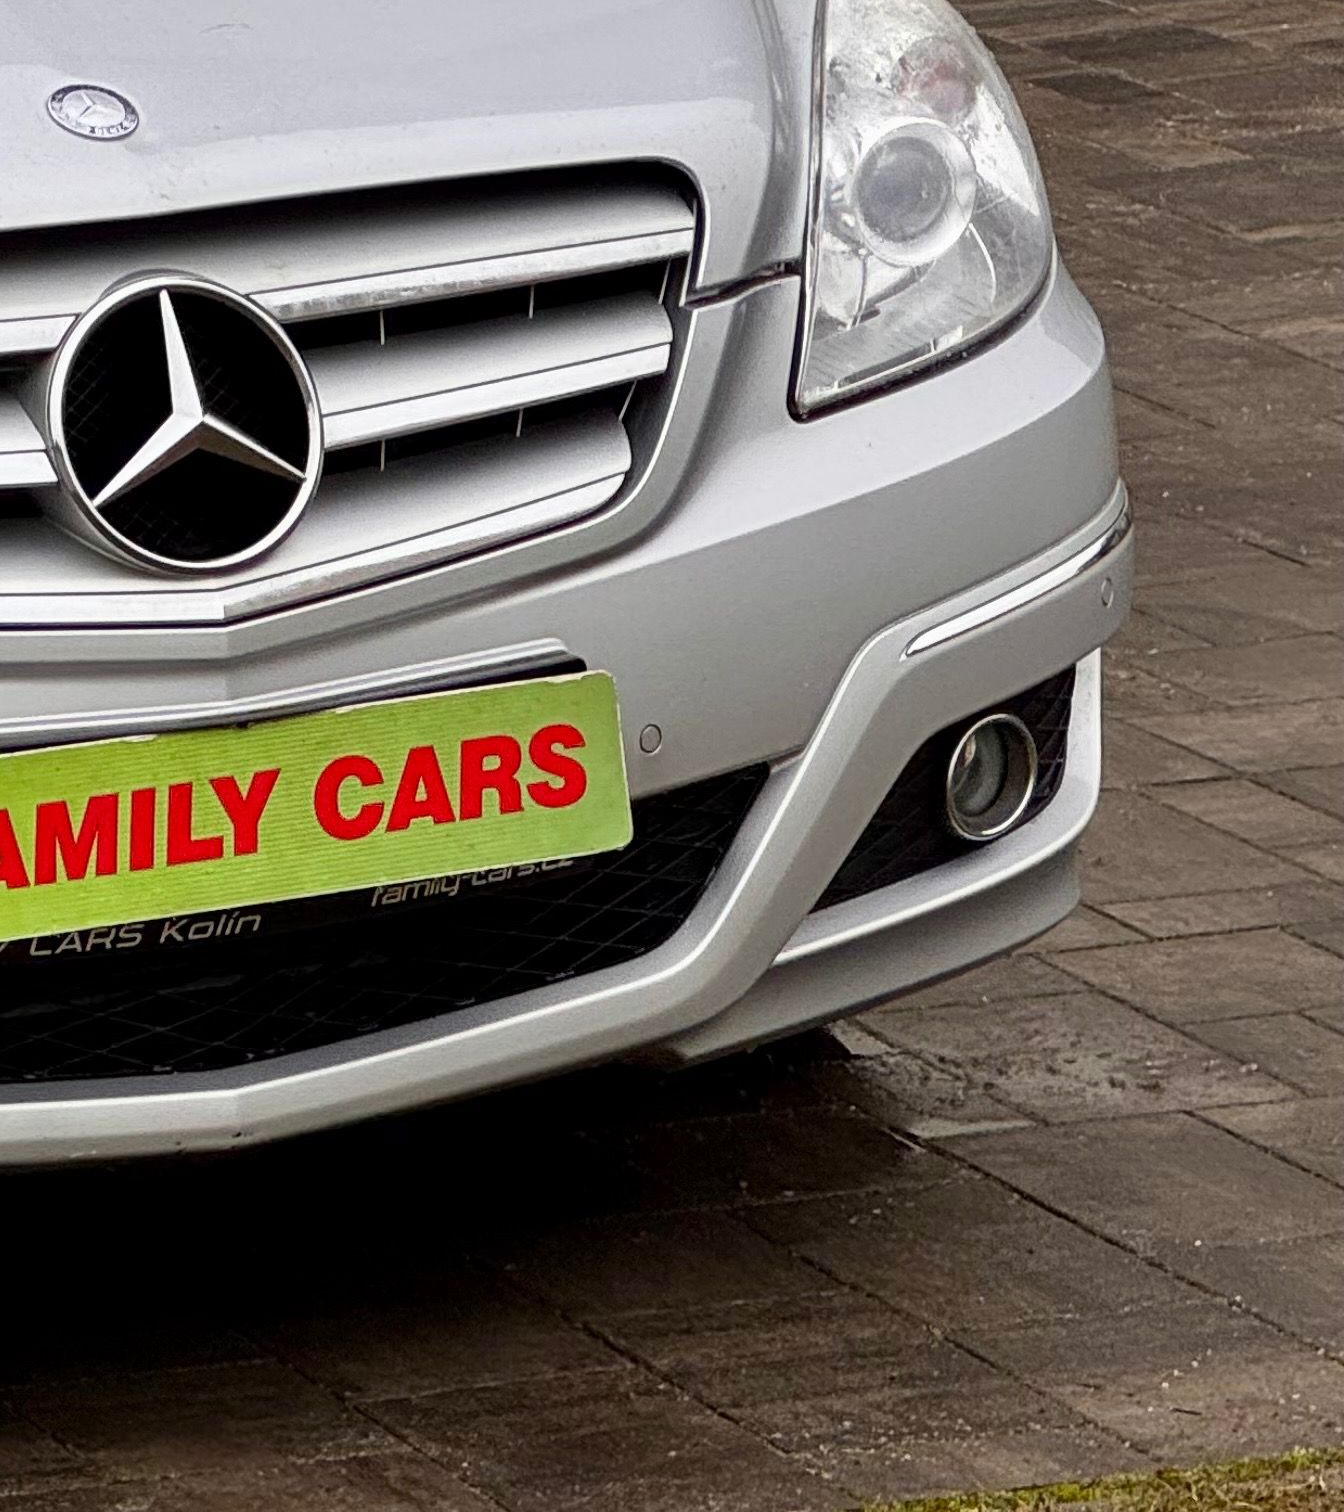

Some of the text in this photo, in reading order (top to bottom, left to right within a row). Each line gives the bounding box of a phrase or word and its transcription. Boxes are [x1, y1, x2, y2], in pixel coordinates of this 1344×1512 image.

[313, 722, 588, 842] CARS
[29, 921, 145, 956] CARS
[159, 910, 262, 944] Kolín
